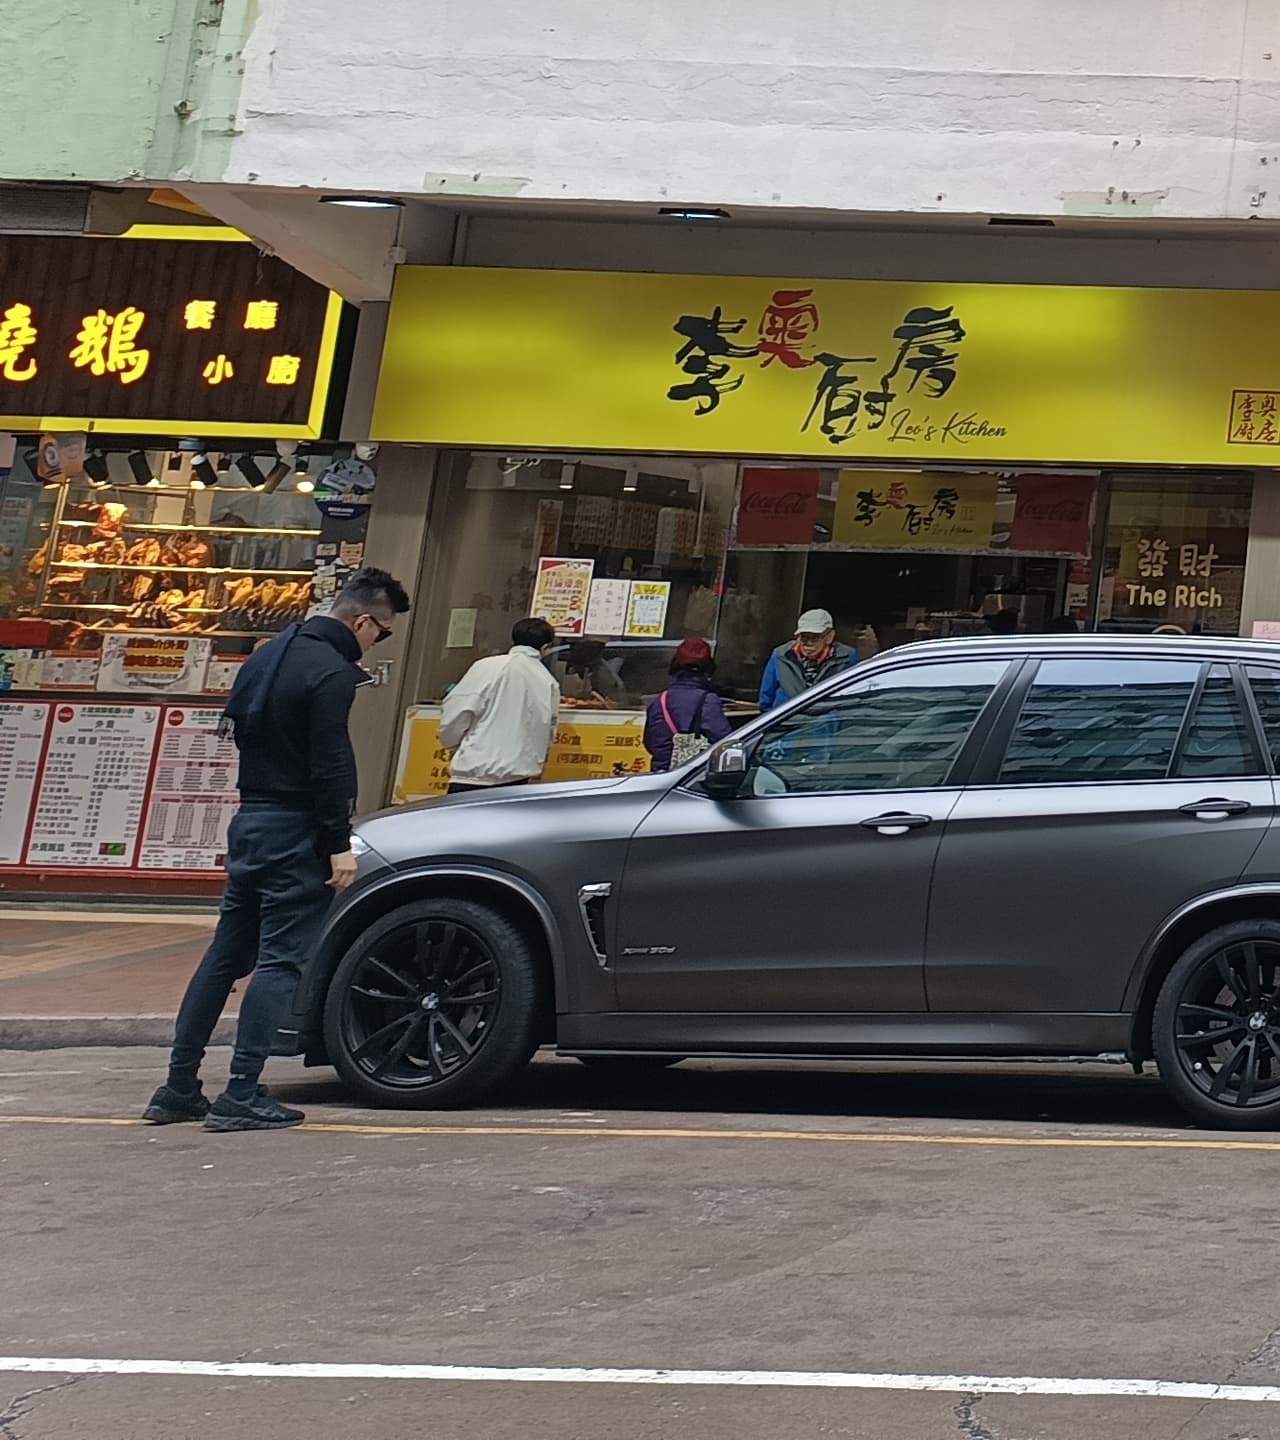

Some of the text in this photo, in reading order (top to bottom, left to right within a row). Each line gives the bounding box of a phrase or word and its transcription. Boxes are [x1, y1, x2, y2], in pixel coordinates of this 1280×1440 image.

[888, 408, 1008, 444] Leo's Kitchen
[1136, 538, 1219, 577] 發財
[1126, 584, 1222, 608] The Rich
